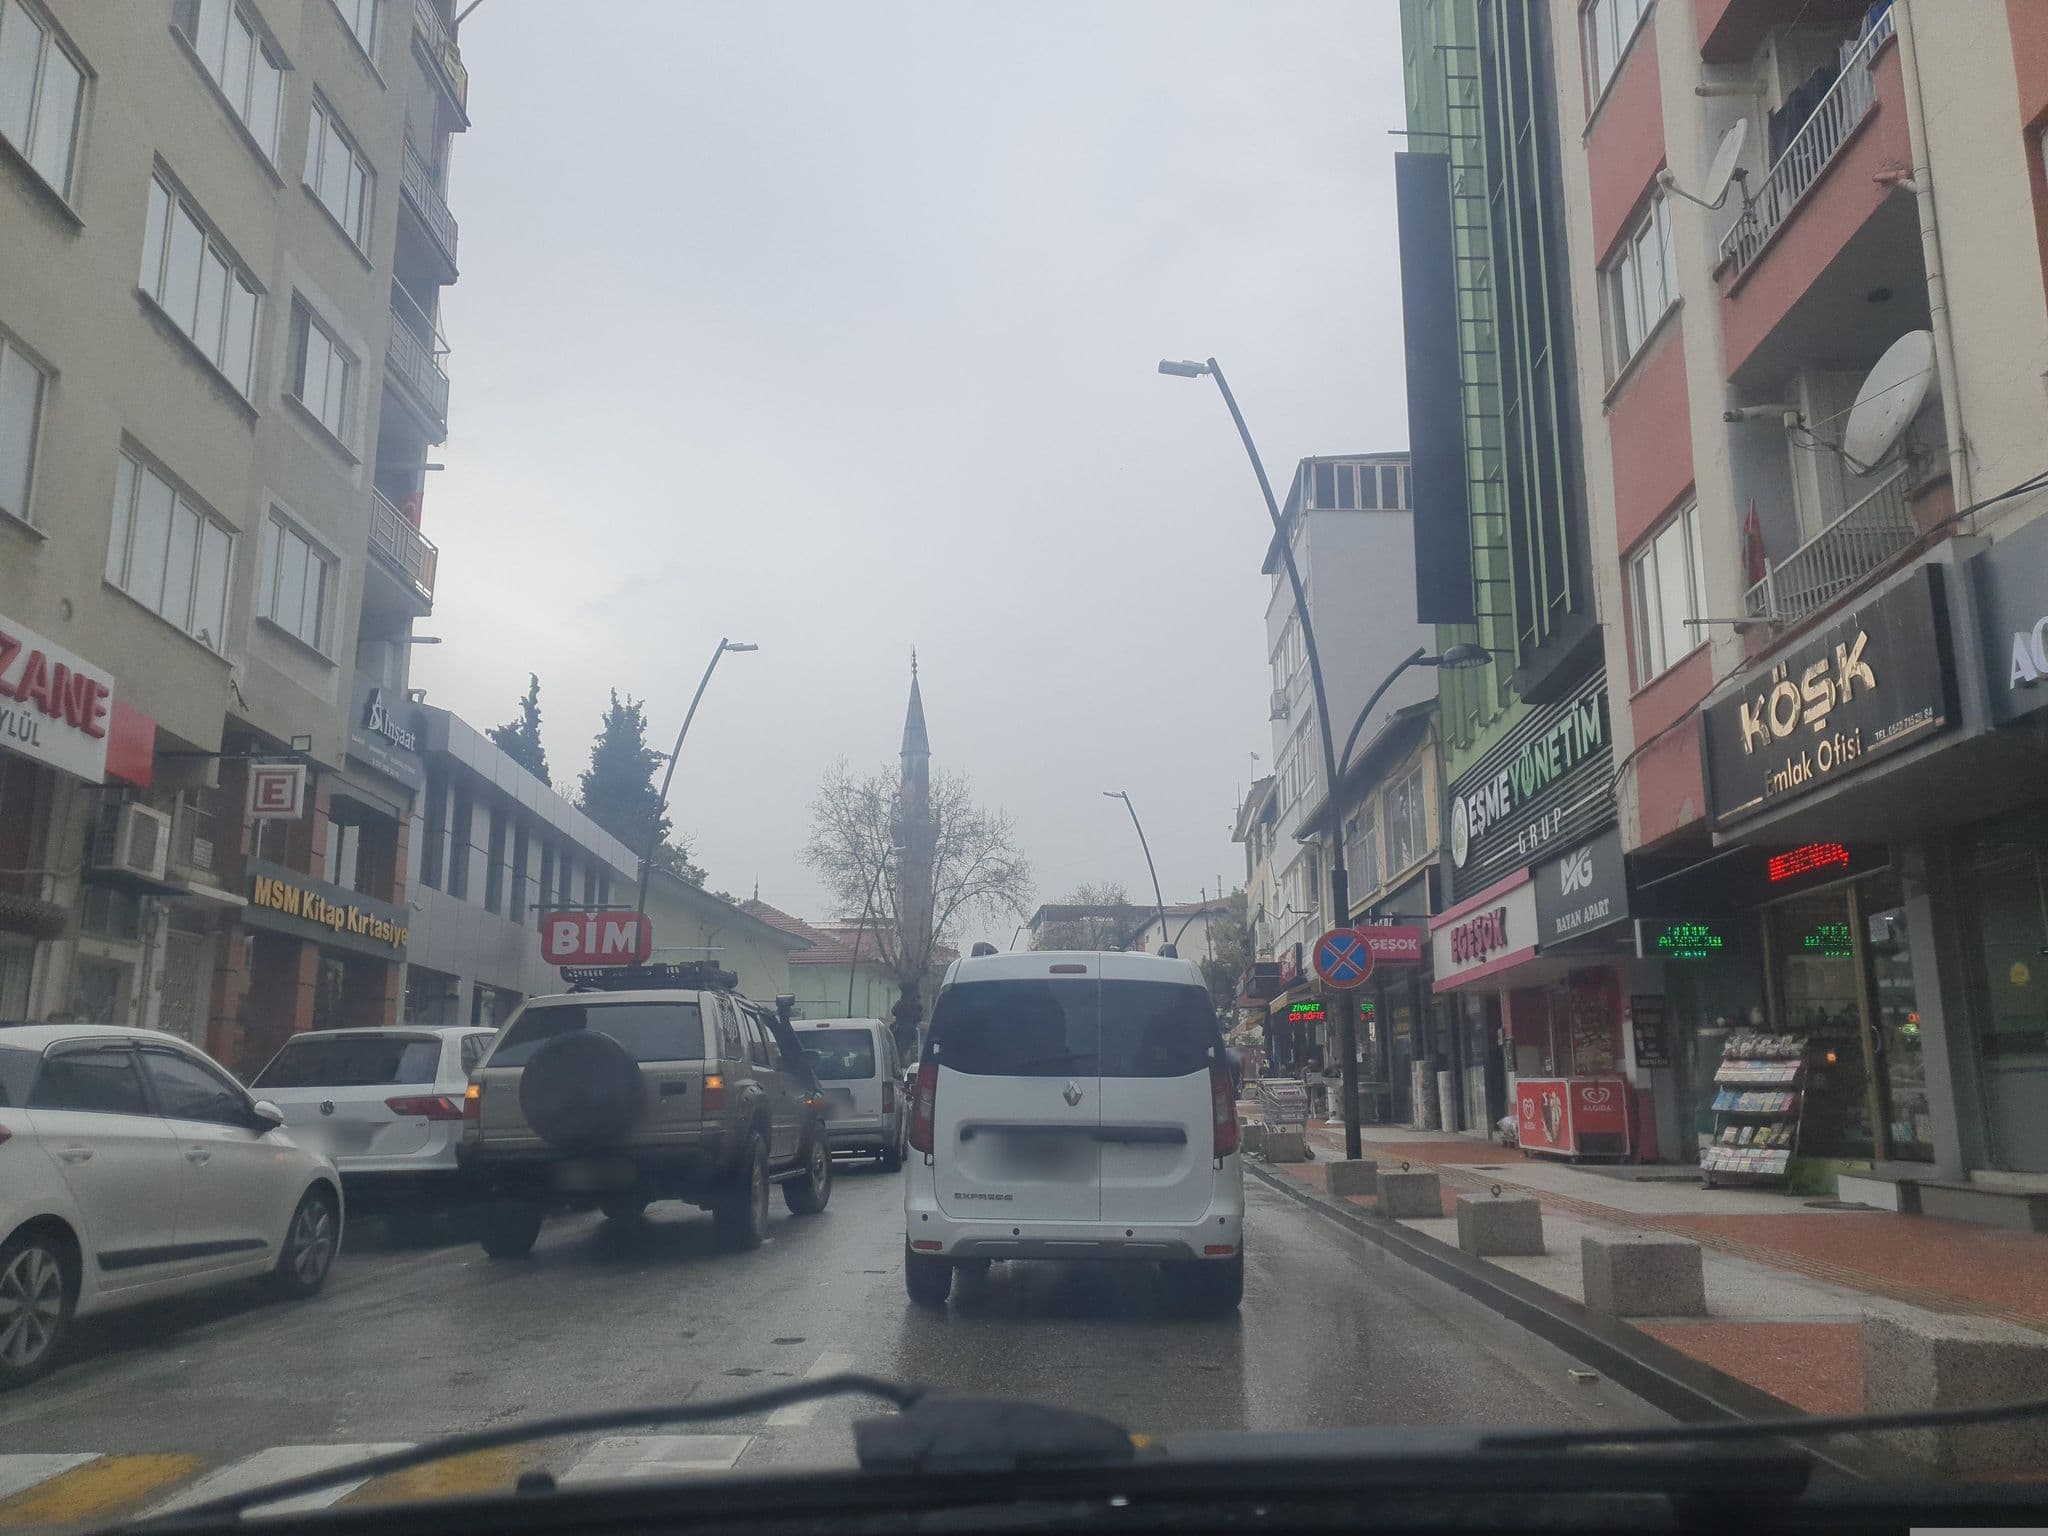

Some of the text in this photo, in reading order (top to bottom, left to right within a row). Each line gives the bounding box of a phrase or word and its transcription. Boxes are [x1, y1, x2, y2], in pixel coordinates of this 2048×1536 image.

[1740, 631, 1876, 754] KÖŞK
[1764, 727, 1862, 798] Emlak Ofisi
[263, 778, 287, 805] E
[1518, 807, 1562, 854] GRUP
[255, 874, 408, 949] MSM Kitap Kırtasiye
[551, 912, 638, 955] BİM
[1556, 897, 1610, 934] BAYAN APART
